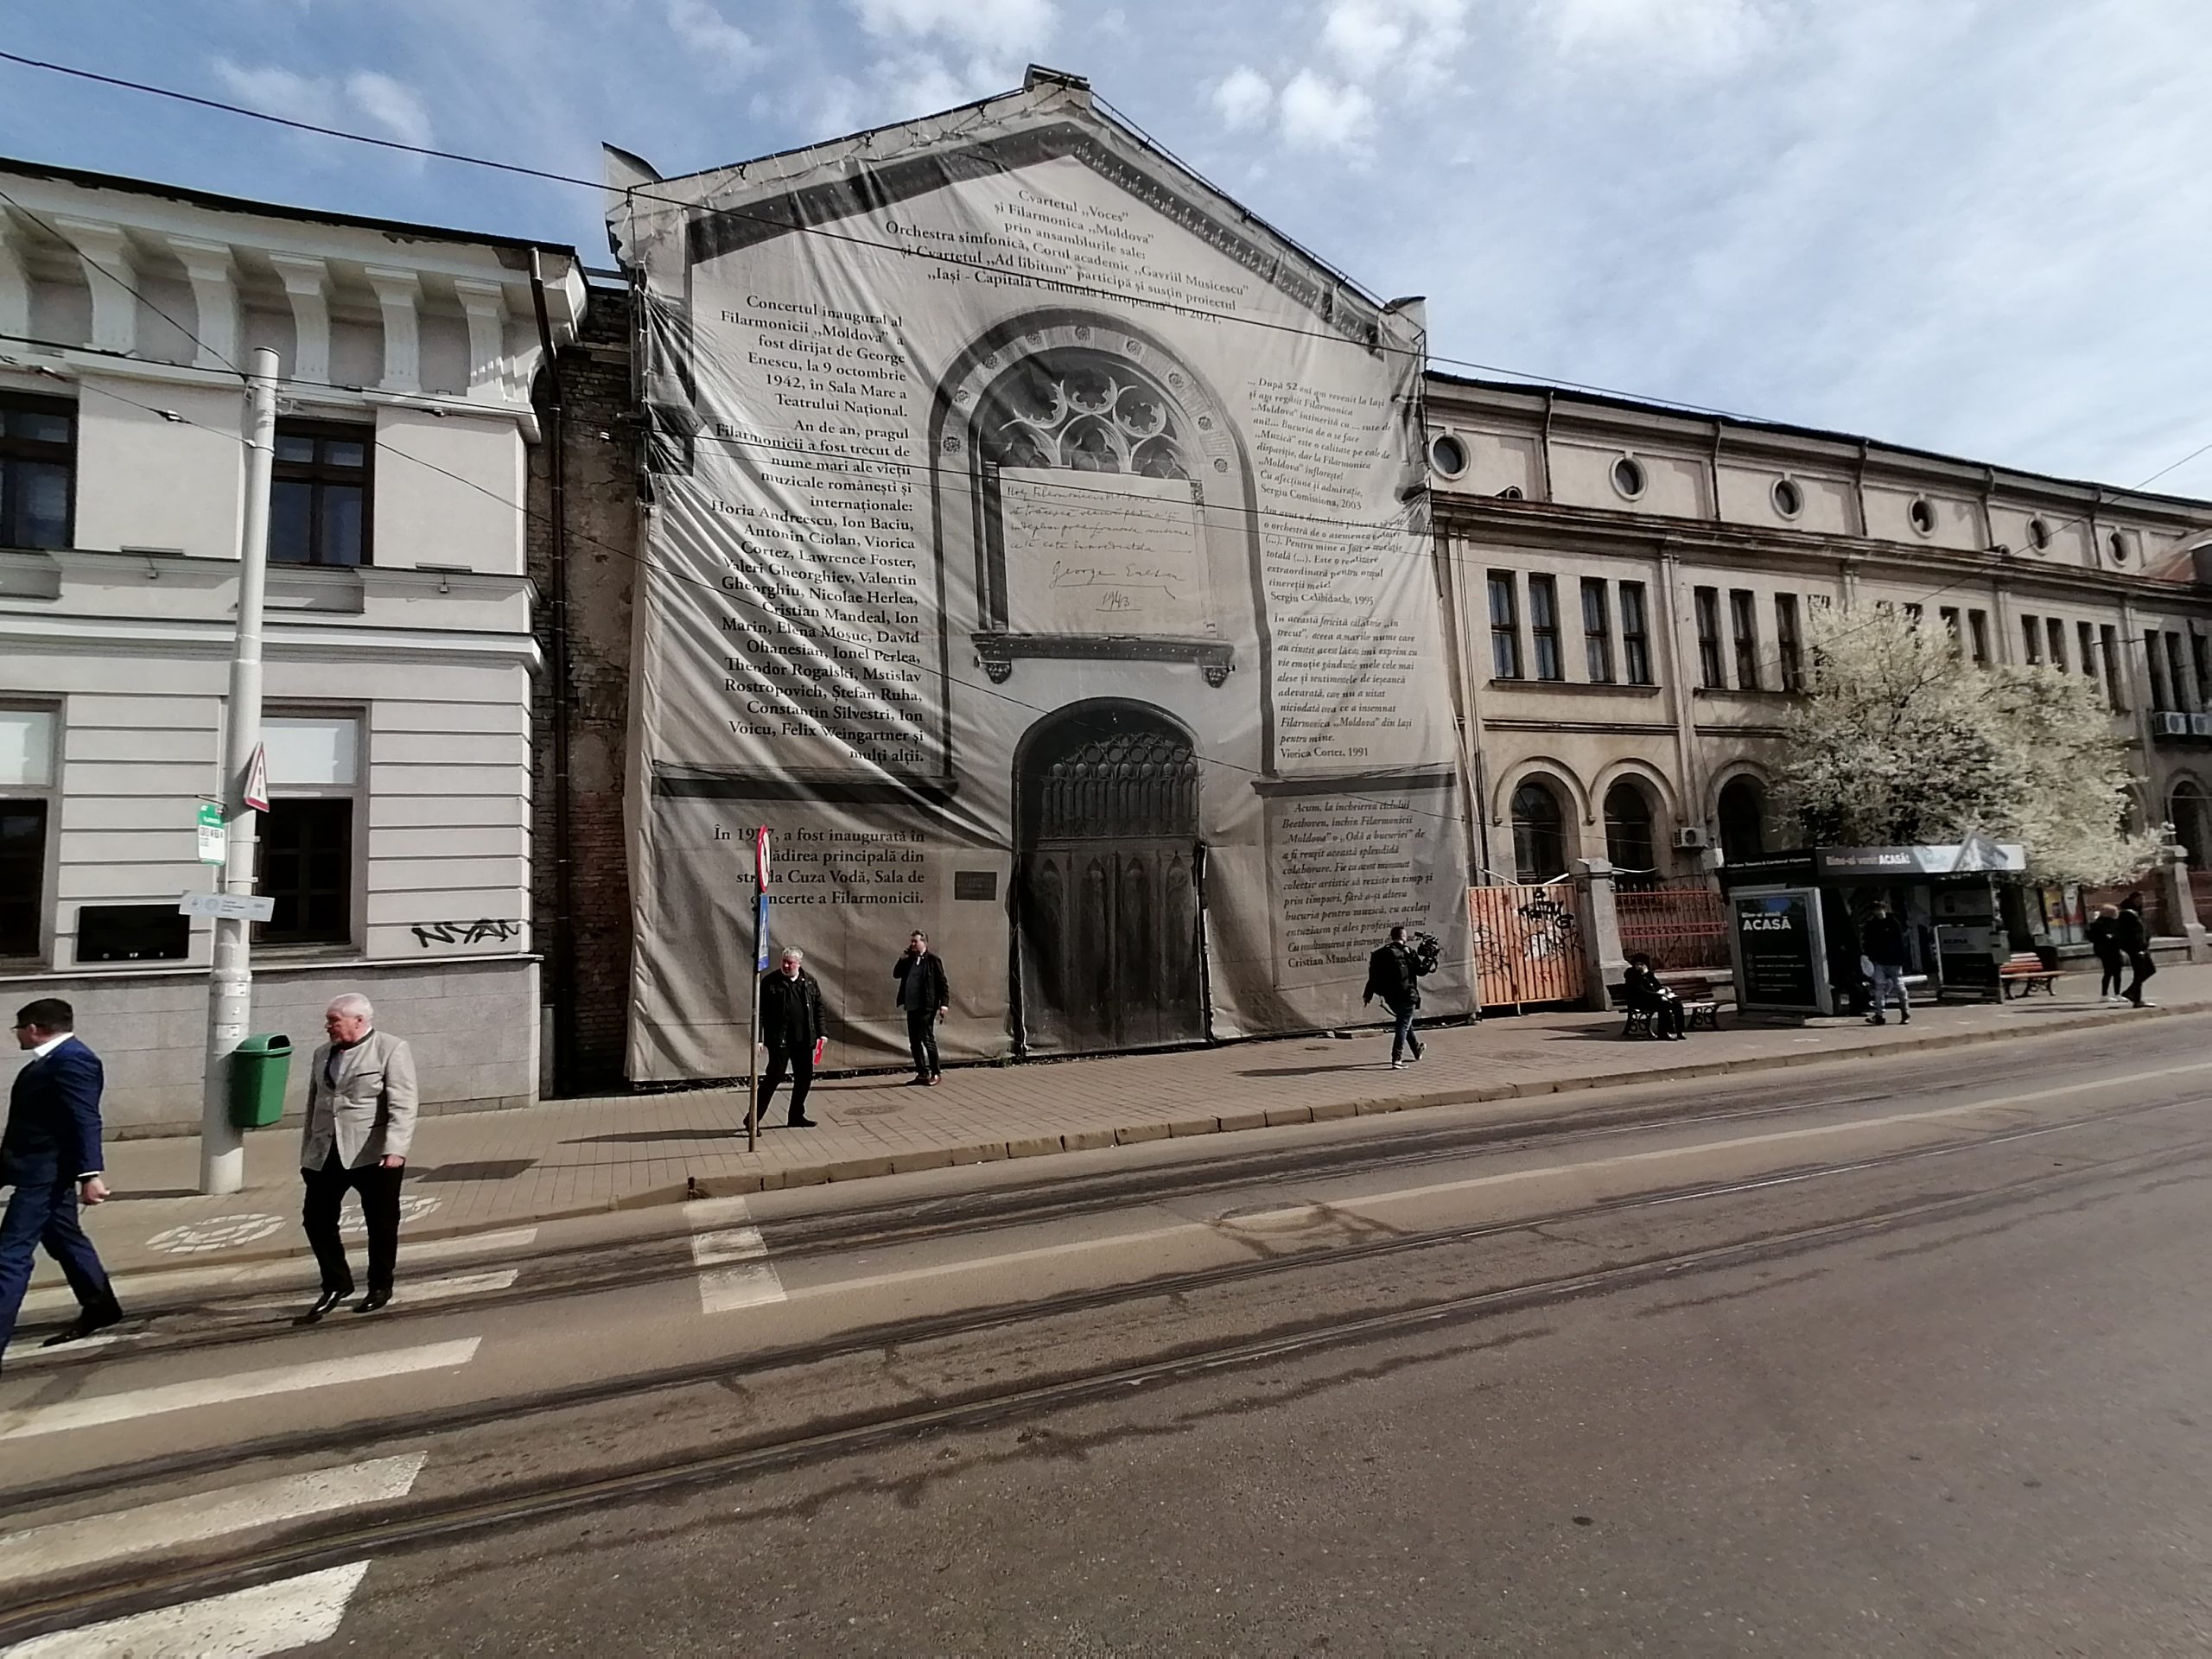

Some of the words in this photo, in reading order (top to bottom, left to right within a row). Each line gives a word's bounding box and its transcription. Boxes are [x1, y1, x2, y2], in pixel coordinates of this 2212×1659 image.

[1018, 189, 1077, 213] Cvartetul
[995, 203, 1004, 216] și
[1007, 203, 1084, 232] Filarmonica
[886, 221, 955, 243] Orchestra
[1033, 241, 1071, 260] Corul
[1074, 252, 1130, 272] academic
[1004, 220, 1032, 237] prin
[1035, 226, 1116, 251] ansamblurile
[899, 244, 912, 259] și
[916, 245, 982, 264] Cvartetul
[1135, 279, 1144, 293] și
[1147, 281, 1182, 300] susțin
[1185, 291, 1236, 311] proiectul
[747, 295, 817, 315] Concertul
[823, 307, 887, 325] inaugural
[891, 315, 903, 327] al
[721, 310, 809, 333] Filarmonicii
[897, 337, 904, 346] a
[759, 334, 784, 349] fost
[789, 338, 833, 357] dirijat
[836, 346, 853, 358] de
[856, 347, 905, 365] George
[748, 352, 802, 372] Enescu,
[807, 359, 819, 372] la
[823, 362, 831, 374] 9
[836, 365, 906, 381] octombrie
[766, 374, 805, 390] 1942,
[810, 379, 823, 391] în
[829, 381, 855, 395] Sala
[861, 384, 896, 397] Mare
[775, 393, 839, 410] Teatrului
[844, 401, 907, 418] Național.
[715, 423, 803, 449] Filarmonicii
[819, 439, 845, 452] fost
[849, 442, 889, 455] trecut
[894, 444, 911, 457] de
[794, 420, 813, 432] An
[819, 420, 835, 434] de
[839, 427, 861, 437] an,
[865, 428, 909, 442] pragul
[772, 455, 811, 469] nume
[817, 461, 849, 471] mari
[853, 461, 872, 473] ale
[877, 463, 911, 478] vieții
[761, 473, 823, 489] muzicale
[828, 476, 896, 495] românești
[901, 483, 912, 495] și
[712, 499, 754, 516] Horia
[760, 506, 837, 528] Andreescu,
[842, 516, 865, 528] Ion
[871, 518, 914, 531] Baciu,
[810, 495, 913, 513] internaționale:
[744, 524, 804, 542] Antonin
[809, 532, 861, 547] Ciolan,
[864, 536, 915, 549] Viorica
[741, 541, 794, 559] Cortez,
[799, 550, 866, 564] Lawrence
[871, 555, 916, 569] Foster,
[723, 556, 764, 574] Valeri
[768, 563, 855, 585] Gheorghiev,
[859, 571, 916, 585] Valentin
[721, 576, 804, 599] Gheorghiu,
[809, 588, 862, 602] Nicolae
[868, 592, 918, 605] Herlea,
[763, 601, 819, 618] Cristian
[824, 607, 890, 625] Mandeal,
[895, 612, 918, 623] Ion
[722, 618, 772, 634] Marin,
[778, 621, 817, 638] Elena
[821, 626, 872, 643] Moșuc,
[877, 632, 919, 643] David
[747, 639, 828, 658] Ohanesian,
[833, 645, 869, 659] Ionel
[874, 651, 920, 664] Perlea,
[725, 658, 787, 676] Theodor
[791, 664, 859, 681] Rogalski,
[862, 667, 921, 682] Mstislav
[724, 678, 827, 699] Rostropovich,
[832, 685, 875, 702] Ștefan
[881, 688, 922, 702] Ruha,
[747, 701, 828, 718] Constantin
[833, 706, 895, 721] Silvestri,
[899, 709, 923, 721] Ion
[729, 721, 776, 736] Voicu,
[781, 722, 817, 737] Felix
[821, 726, 909, 744] Weingartner
[913, 730, 923, 742] și
[849, 749, 887, 764] mulți
[892, 750, 925, 764] alții.
[715, 824, 730, 840] În
[737, 828, 779, 842] 197,
[783, 832, 791, 841] a
[797, 827, 823, 841] fost
[829, 830, 906, 846] inaugurată
[911, 830, 925, 842] în
[769, 850, 818, 862] lădirea
[823, 849, 896, 866] principală
[900, 849, 924, 862] din
[788, 871, 825, 883] Cuza
[830, 870, 870, 884] Vodă,
[874, 871, 904, 883] Sala
[908, 871, 925, 883] de
[750, 894, 814, 905] cncerte
[831, 892, 924, 905] Filarmonicii.
[1743, 917, 1791, 931] ACASĂ
